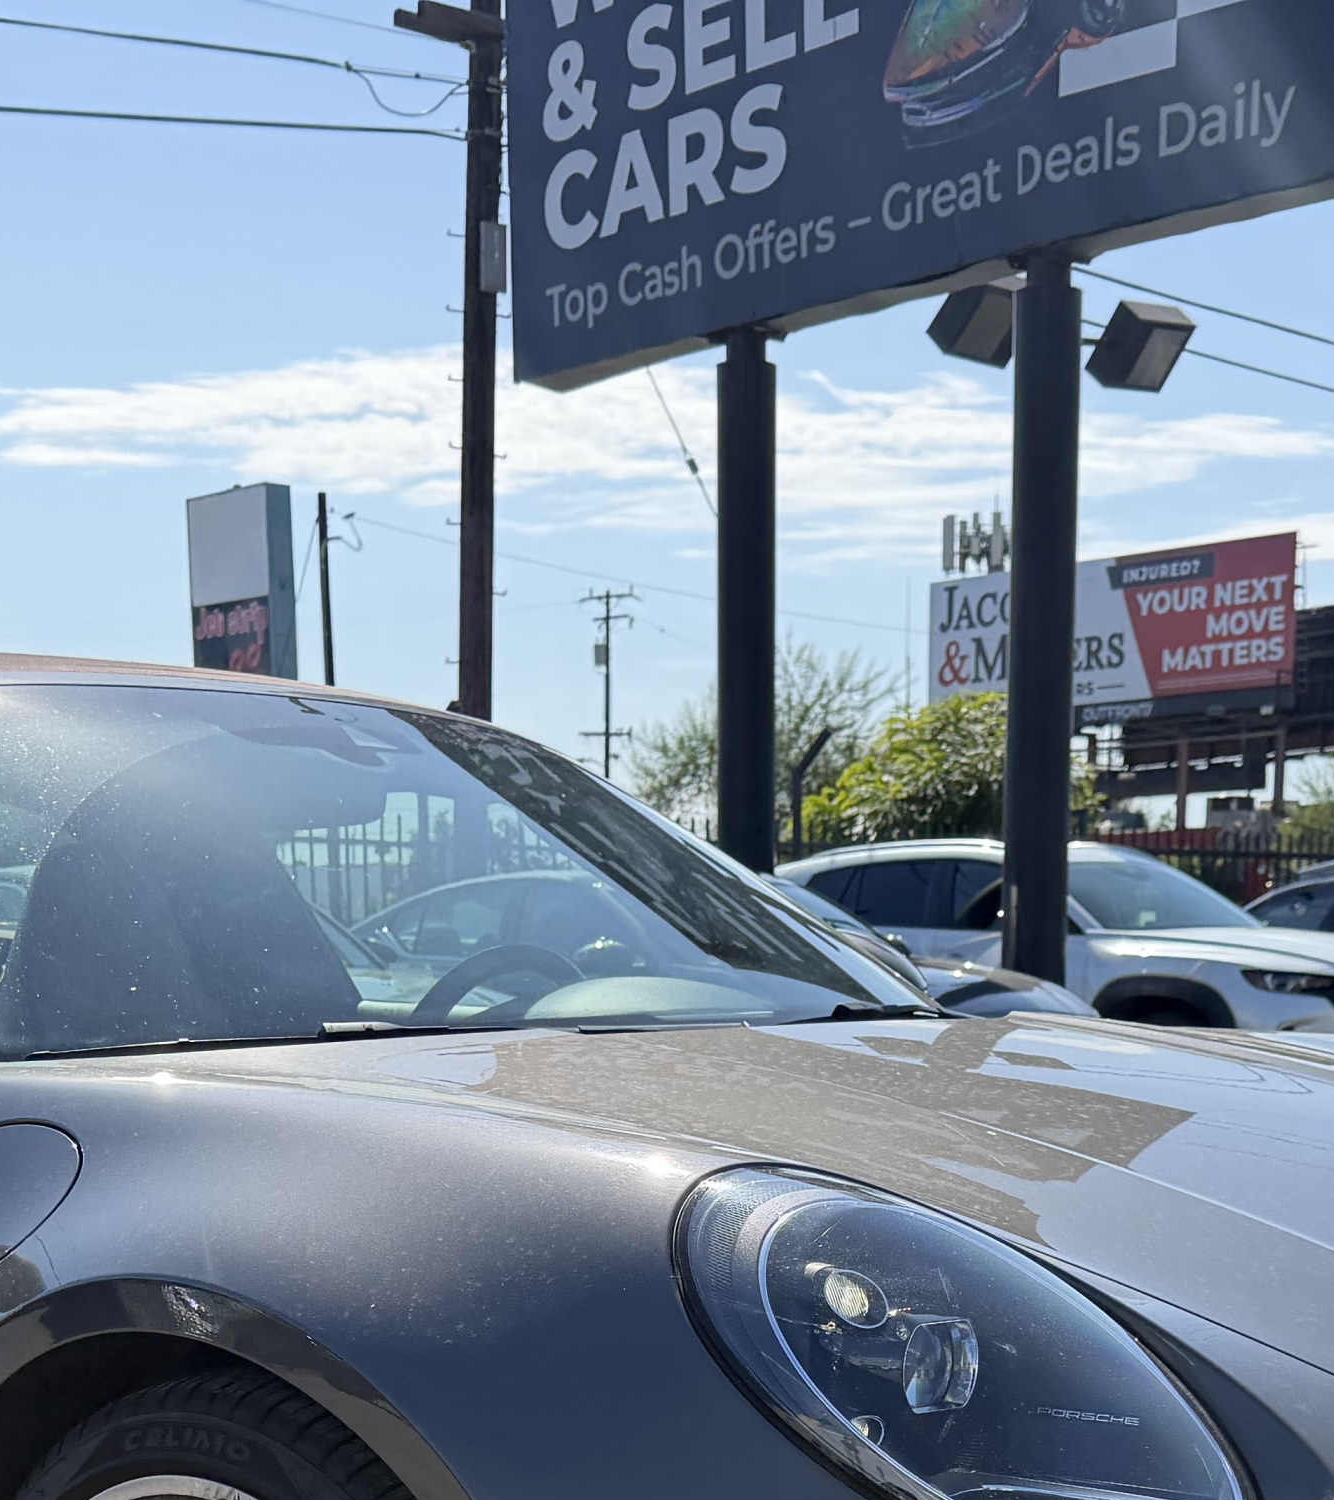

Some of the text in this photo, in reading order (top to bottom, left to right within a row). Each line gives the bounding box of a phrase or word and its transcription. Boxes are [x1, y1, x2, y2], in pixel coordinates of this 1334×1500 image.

[542, 0, 860, 142] & SELL
[544, 83, 787, 250] CARS
[545, 281, 608, 329] Top
[618, 246, 703, 306] Cash
[713, 215, 836, 280] Offers
[881, 158, 1003, 231] Great
[1016, 116, 1141, 196] Deals
[1157, 79, 1297, 158] Daily
[1122, 558, 1201, 584] INJURED?
[939, 585, 1010, 633] JAC
[1135, 574, 1289, 617] YOUR NEXT
[1204, 605, 1286, 639] MOVE
[1161, 636, 1285, 673] MATTERS
[1037, 1406, 1140, 1426] PORSCHE
